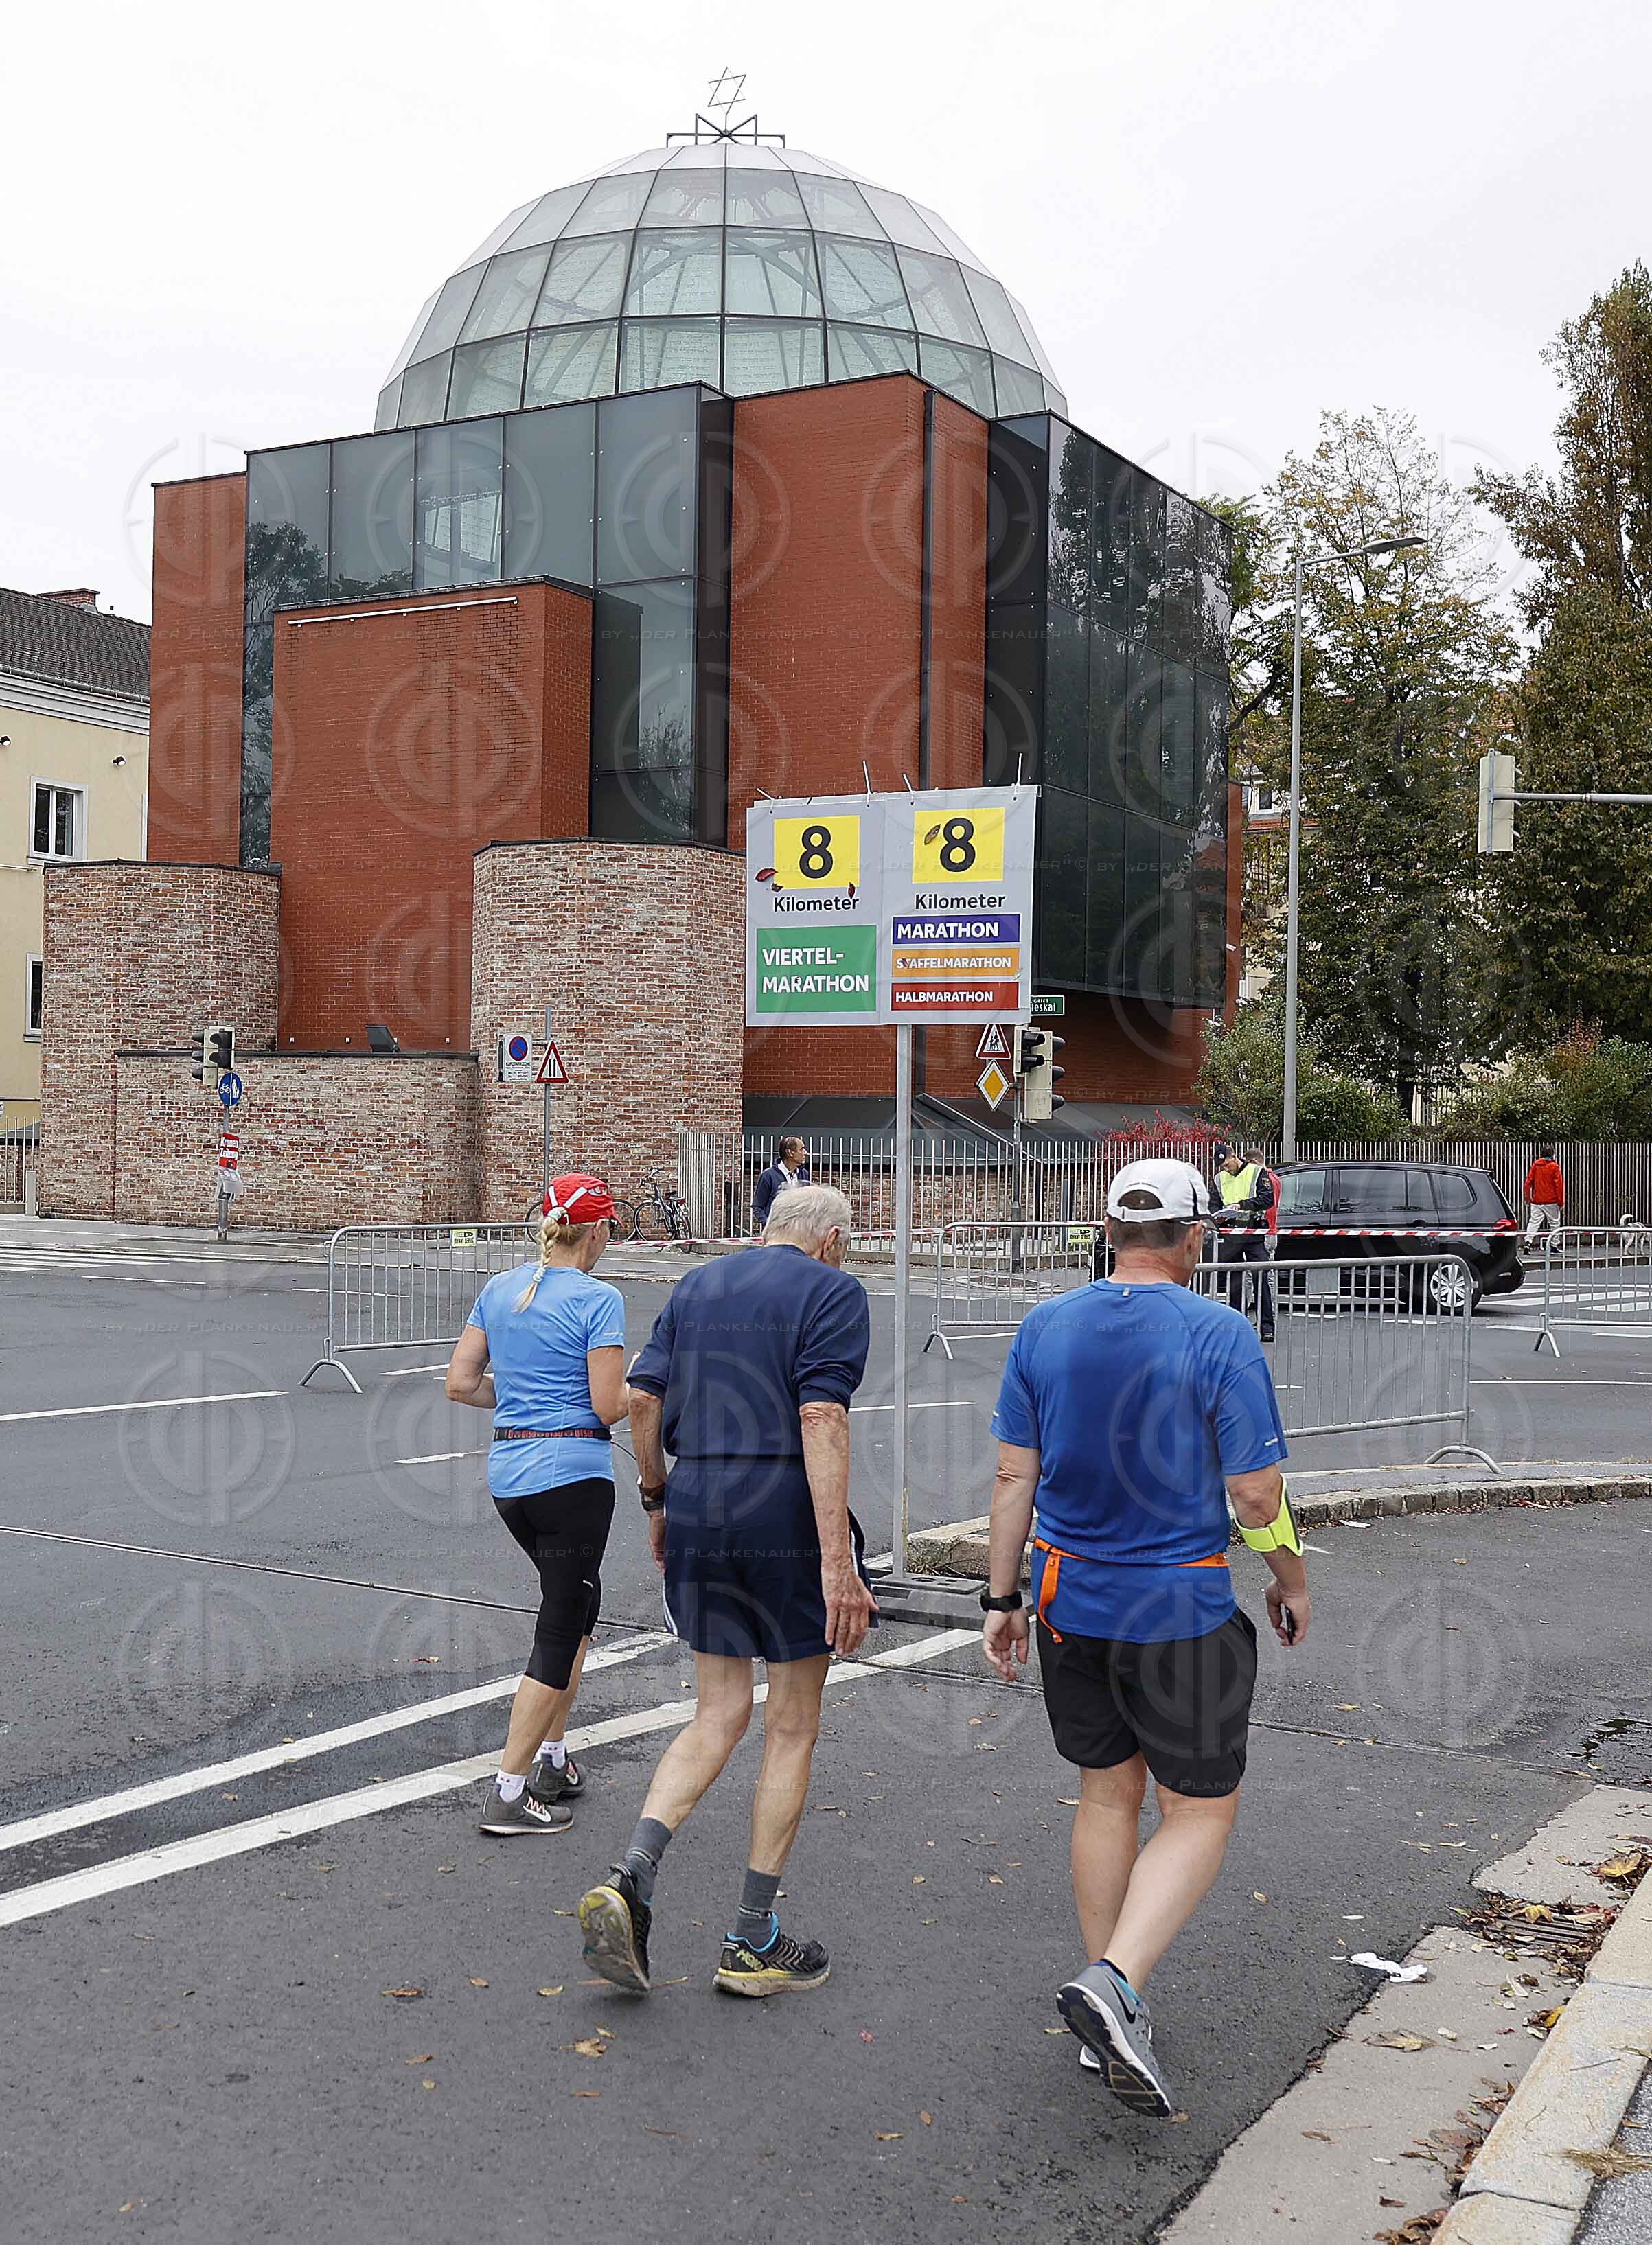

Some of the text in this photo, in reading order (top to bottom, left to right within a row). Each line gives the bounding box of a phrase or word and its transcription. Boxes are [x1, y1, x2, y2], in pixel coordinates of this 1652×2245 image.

[799, 825, 833, 879] 8
[939, 817, 976, 873] 8
[774, 897, 859, 912] Kilometer
[915, 894, 1005, 910] Kilometer
[897, 922, 998, 939] MARATHON
[762, 947, 844, 965] VIERTEL-
[762, 974, 869, 993] MARATHON
[895, 991, 993, 1002] HALBMARATHON
